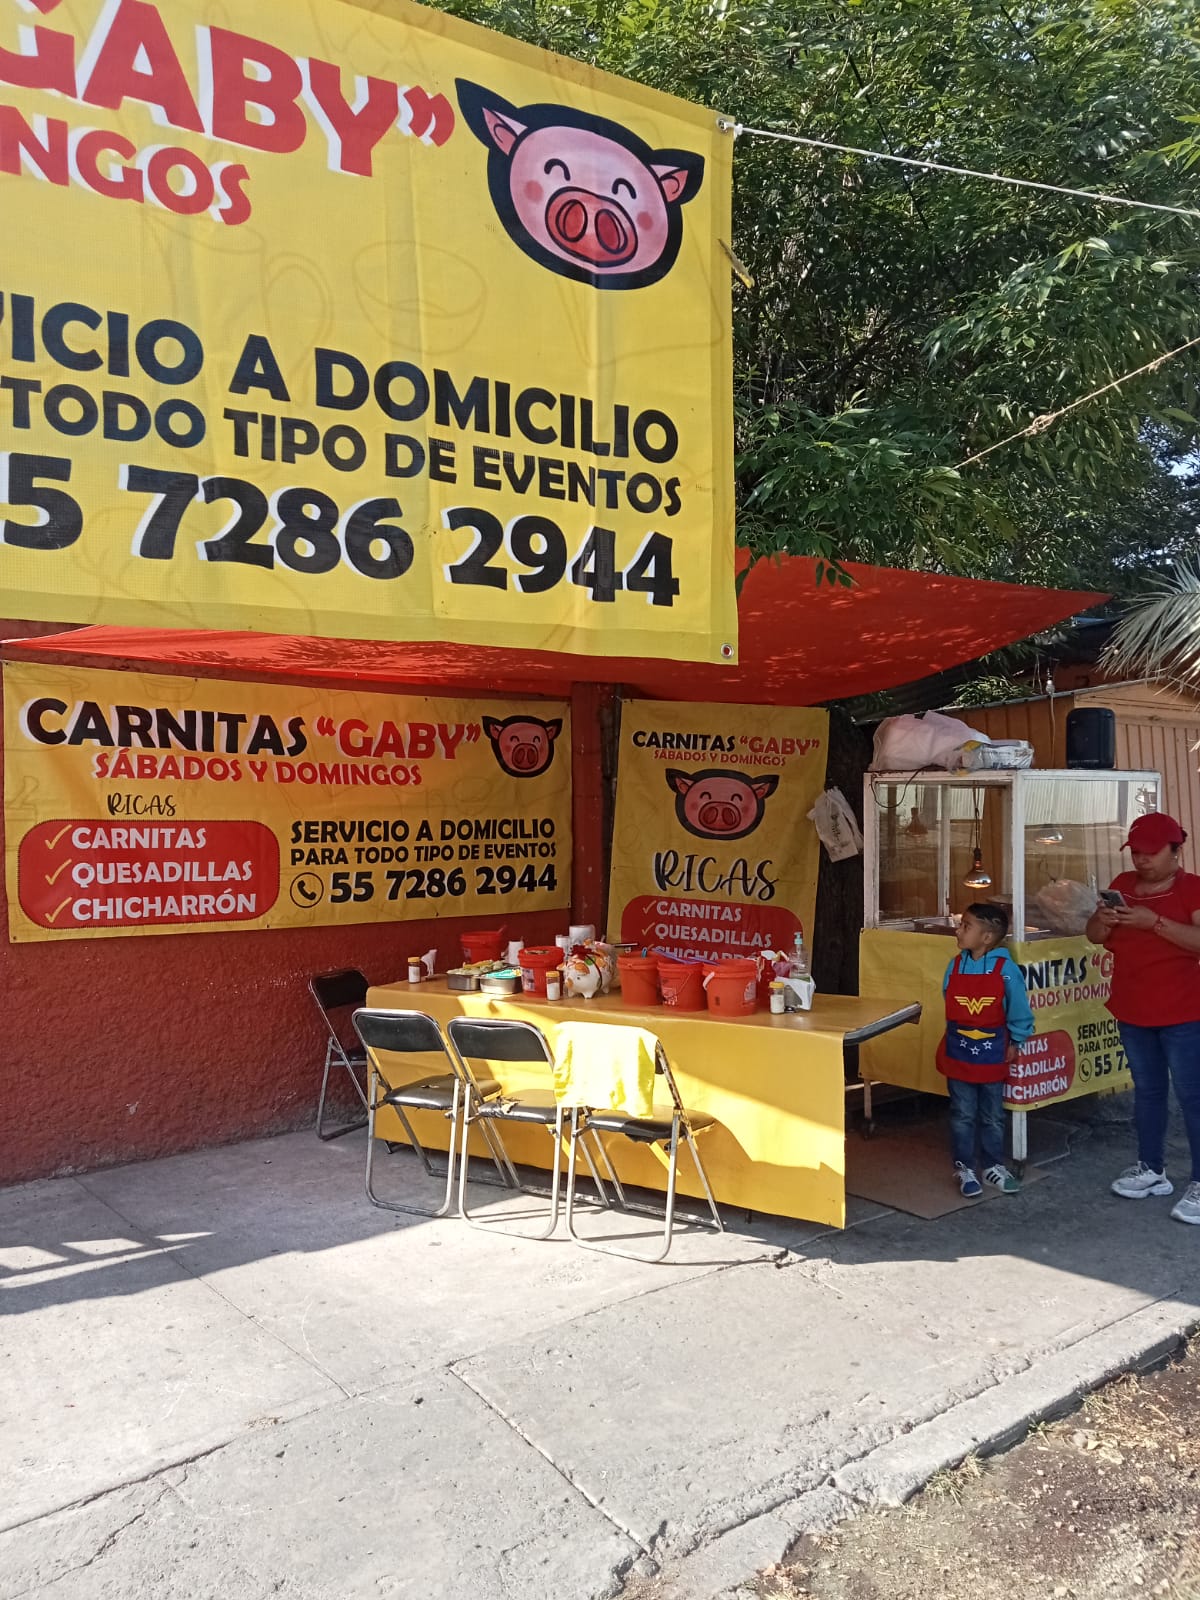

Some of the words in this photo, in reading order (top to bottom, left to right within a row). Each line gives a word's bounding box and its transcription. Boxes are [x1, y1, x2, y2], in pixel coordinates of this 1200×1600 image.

[0, 288, 204, 385] ICIO
[228, 333, 291, 402] A
[314, 347, 679, 464] DOMICILIO
[0, 375, 207, 449] TODO
[223, 407, 367, 472] TIPO
[385, 432, 457, 484] DE
[473, 445, 682, 517] EVENTOS
[120, 464, 415, 580] 7286
[442, 505, 681, 607] 2944
[23, 697, 308, 757] CARNITAS
[315, 714, 481, 760] “GABY”
[632, 730, 735, 752] CARNITAS
[95, 748, 243, 782] SÁBADOS
[249, 760, 268, 782] Y
[275, 761, 422, 785] DOMINGOS
[709, 752, 718, 763] Y
[720, 754, 787, 767] DOMINGOS
[107, 791, 176, 817] RICAS
[71, 827, 206, 850] CARNITAS
[290, 820, 410, 844] SERVICIO
[416, 820, 433, 842] A
[440, 818, 555, 841] DOMICILIO
[290, 847, 349, 866] PARA
[354, 846, 409, 864] TODO
[415, 845, 454, 862] TIPO
[458, 844, 480, 860] DE
[484, 842, 556, 860] EVENTOS
[71, 861, 253, 888] QUESADILLAS
[330, 871, 375, 903] 55
[385, 867, 467, 900] 7286
[475, 863, 557, 895] 2944
[654, 849, 779, 901] RICAS
[71, 888, 257, 921] CHICHARRÓN
[656, 901, 742, 922] CARNITAS
[655, 923, 772, 948] QUESADILLAS
[1063, 988, 1072, 1004] Y
[1077, 1019, 1120, 1041] SERVICI
[1078, 1041, 1101, 1055] PARA
[1094, 1053, 1112, 1077] 55
